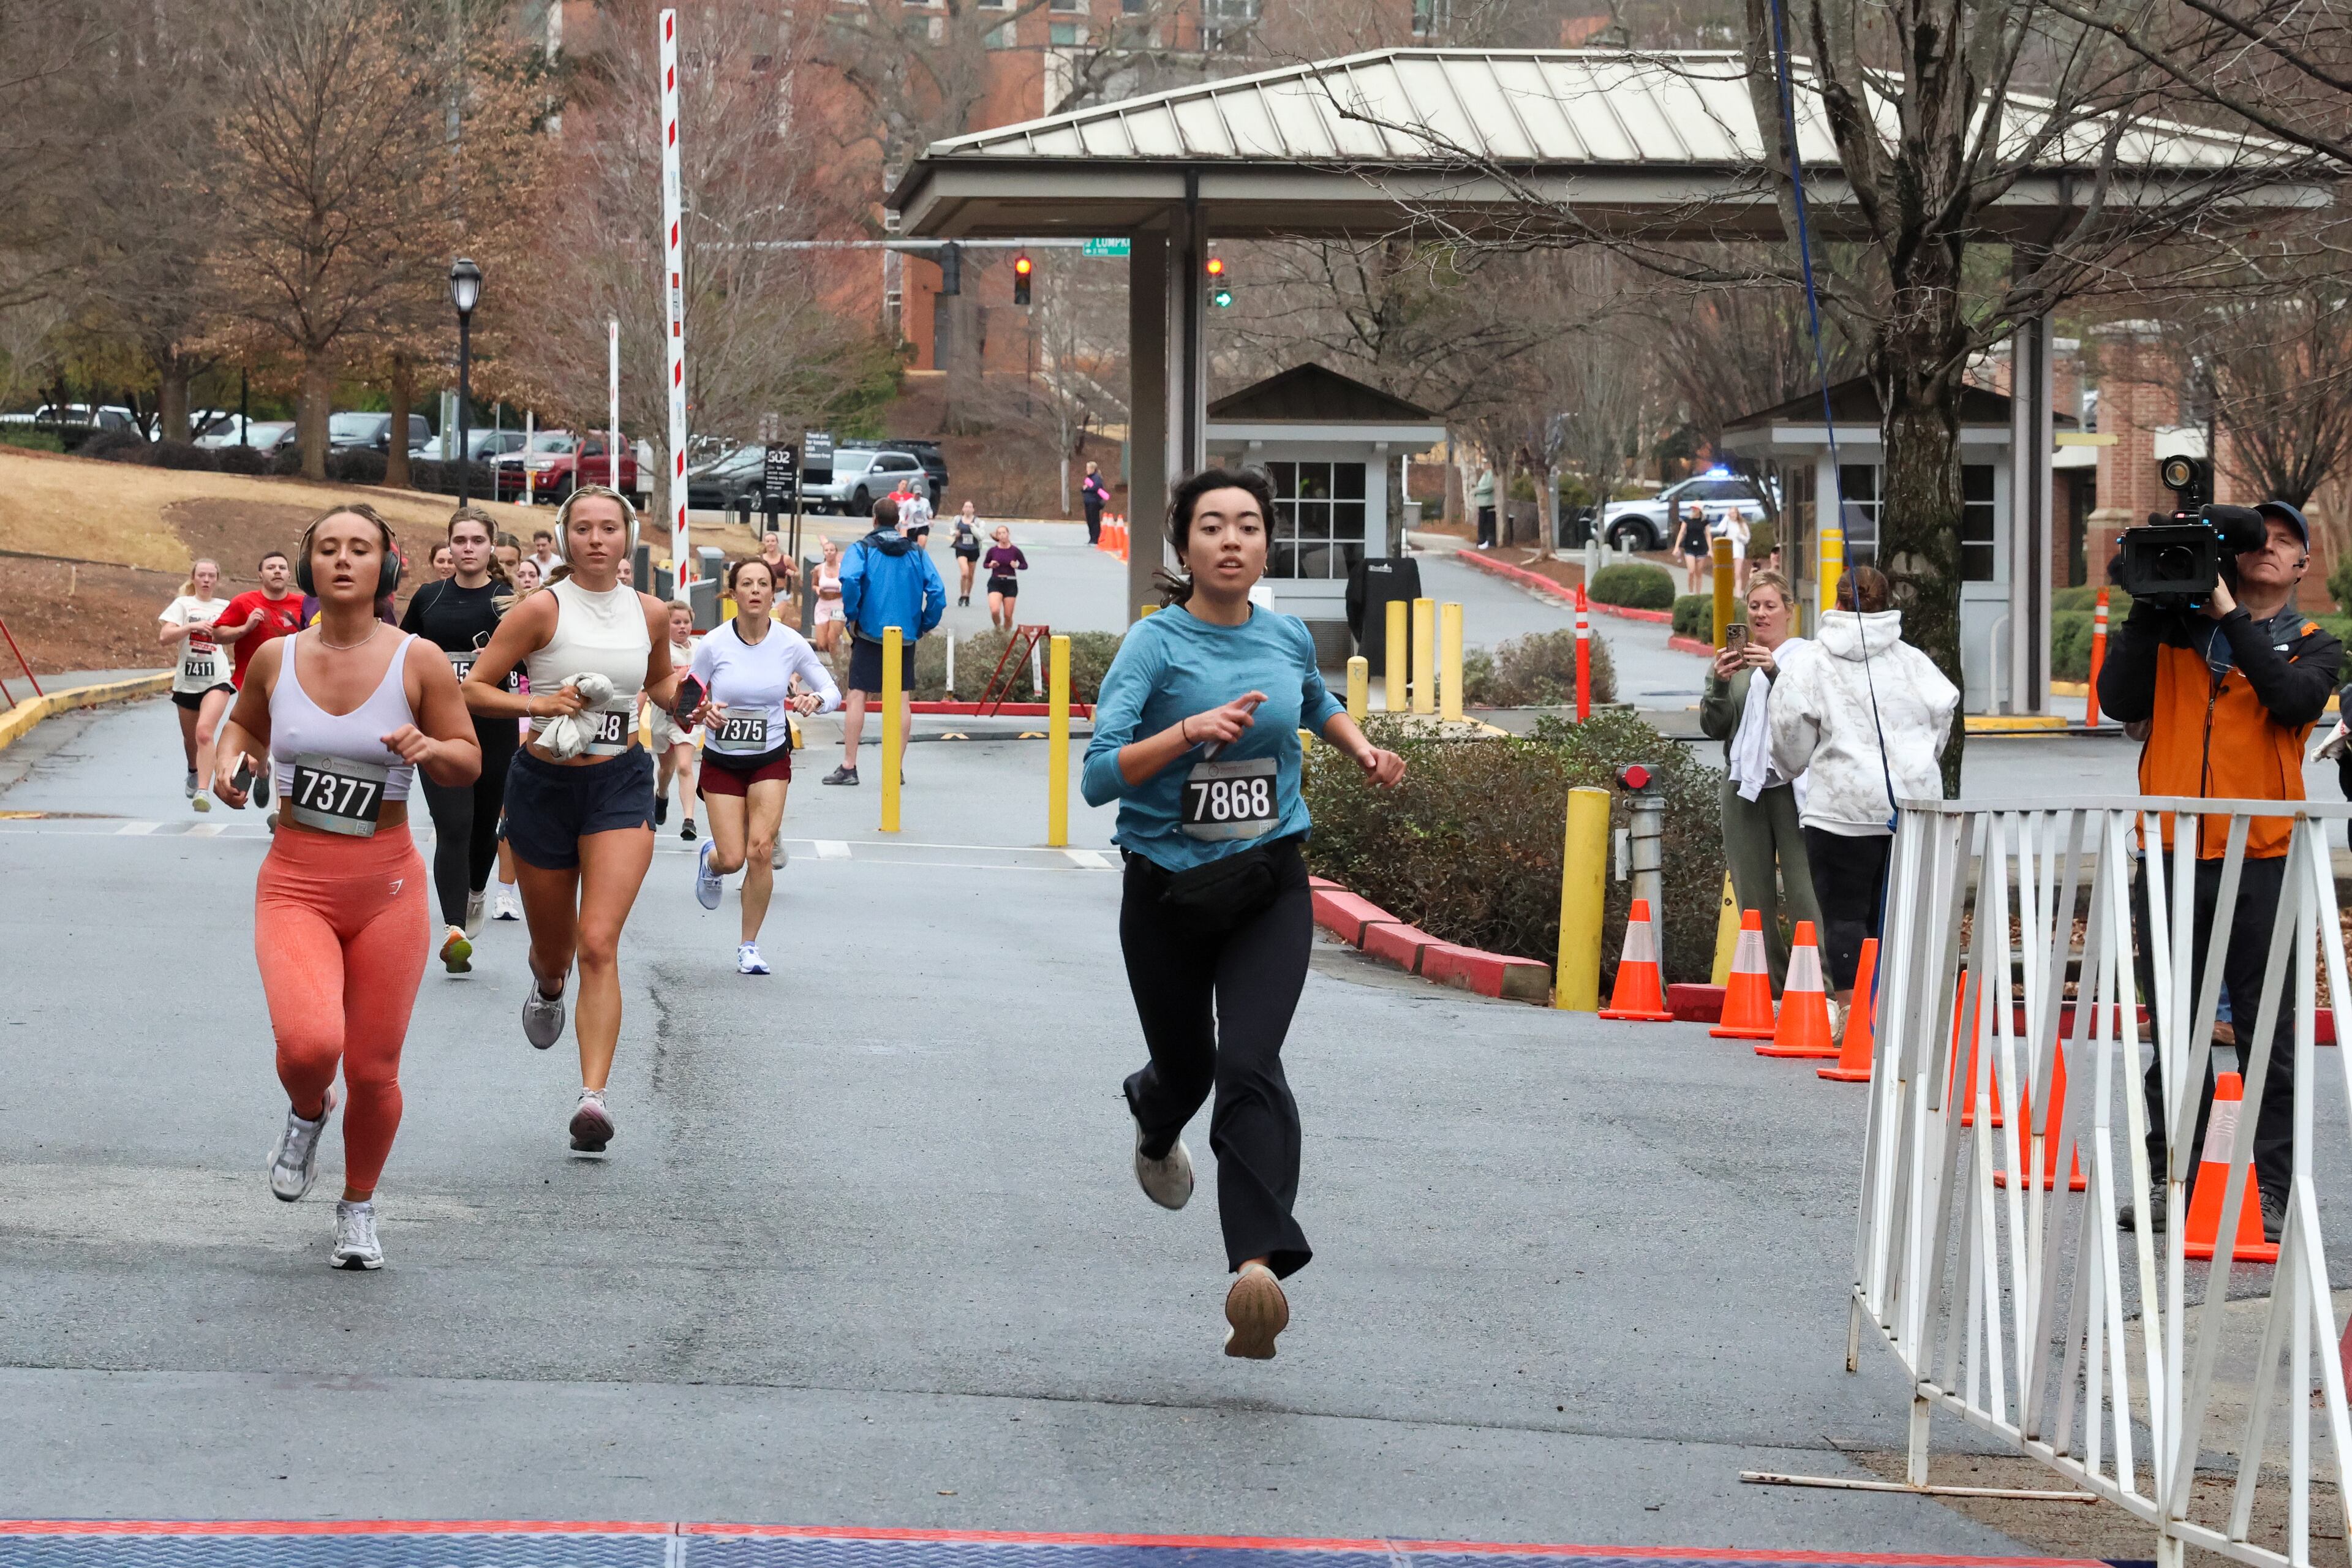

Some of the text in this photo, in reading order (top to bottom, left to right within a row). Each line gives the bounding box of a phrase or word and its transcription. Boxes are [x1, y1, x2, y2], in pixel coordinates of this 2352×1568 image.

[187, 662, 212, 676] 7411
[721, 719, 763, 741] 7375
[300, 769, 377, 817] 7377
[1190, 778, 1270, 821] 7868
